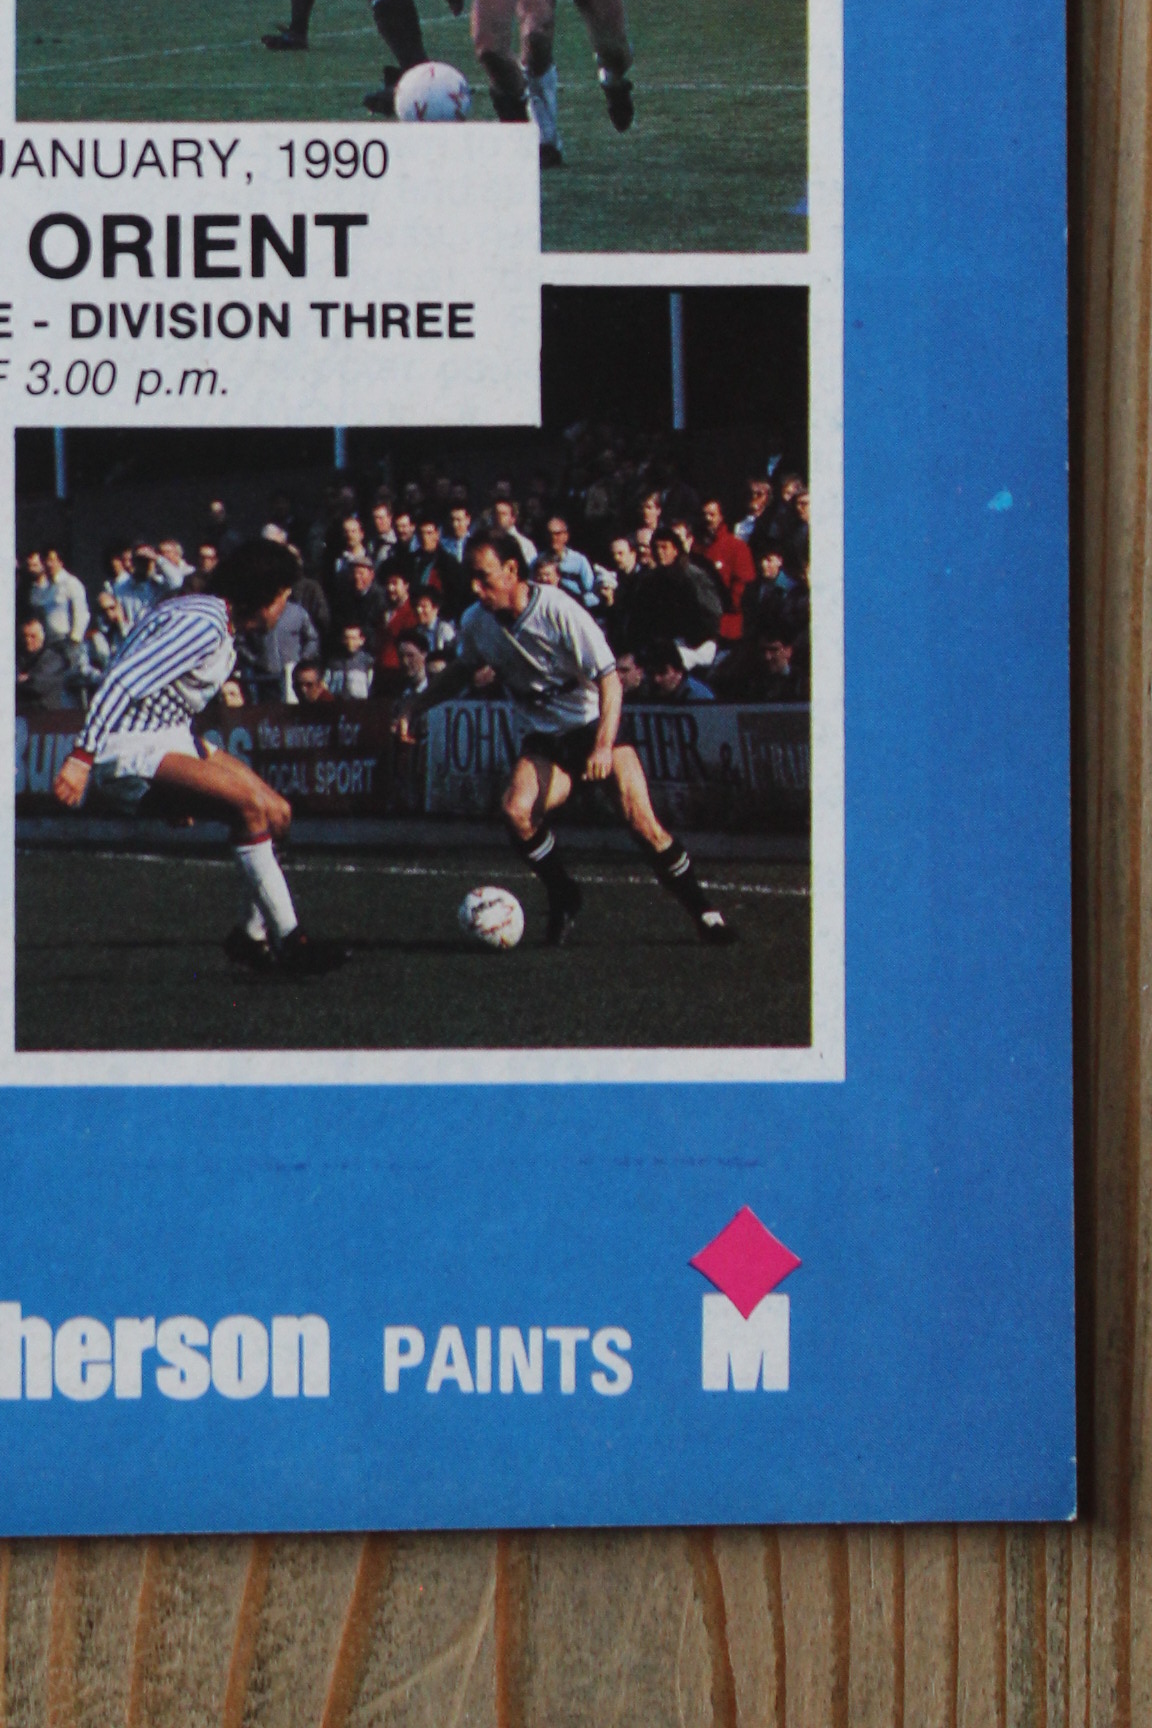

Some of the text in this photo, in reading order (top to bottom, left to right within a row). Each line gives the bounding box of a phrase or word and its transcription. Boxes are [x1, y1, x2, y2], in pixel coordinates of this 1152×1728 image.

[278, 139, 390, 179] 1990
[27, 211, 370, 280] ORIENT
[69, 301, 291, 340] DIVISION
[309, 301, 476, 340] THREE
[25, 358, 118, 398] 3.00
[135, 366, 231, 405] p.m.
[314, 758, 378, 795] SPORT
[383, 1324, 634, 1397] PAINTS
[701, 1292, 791, 1392] M
